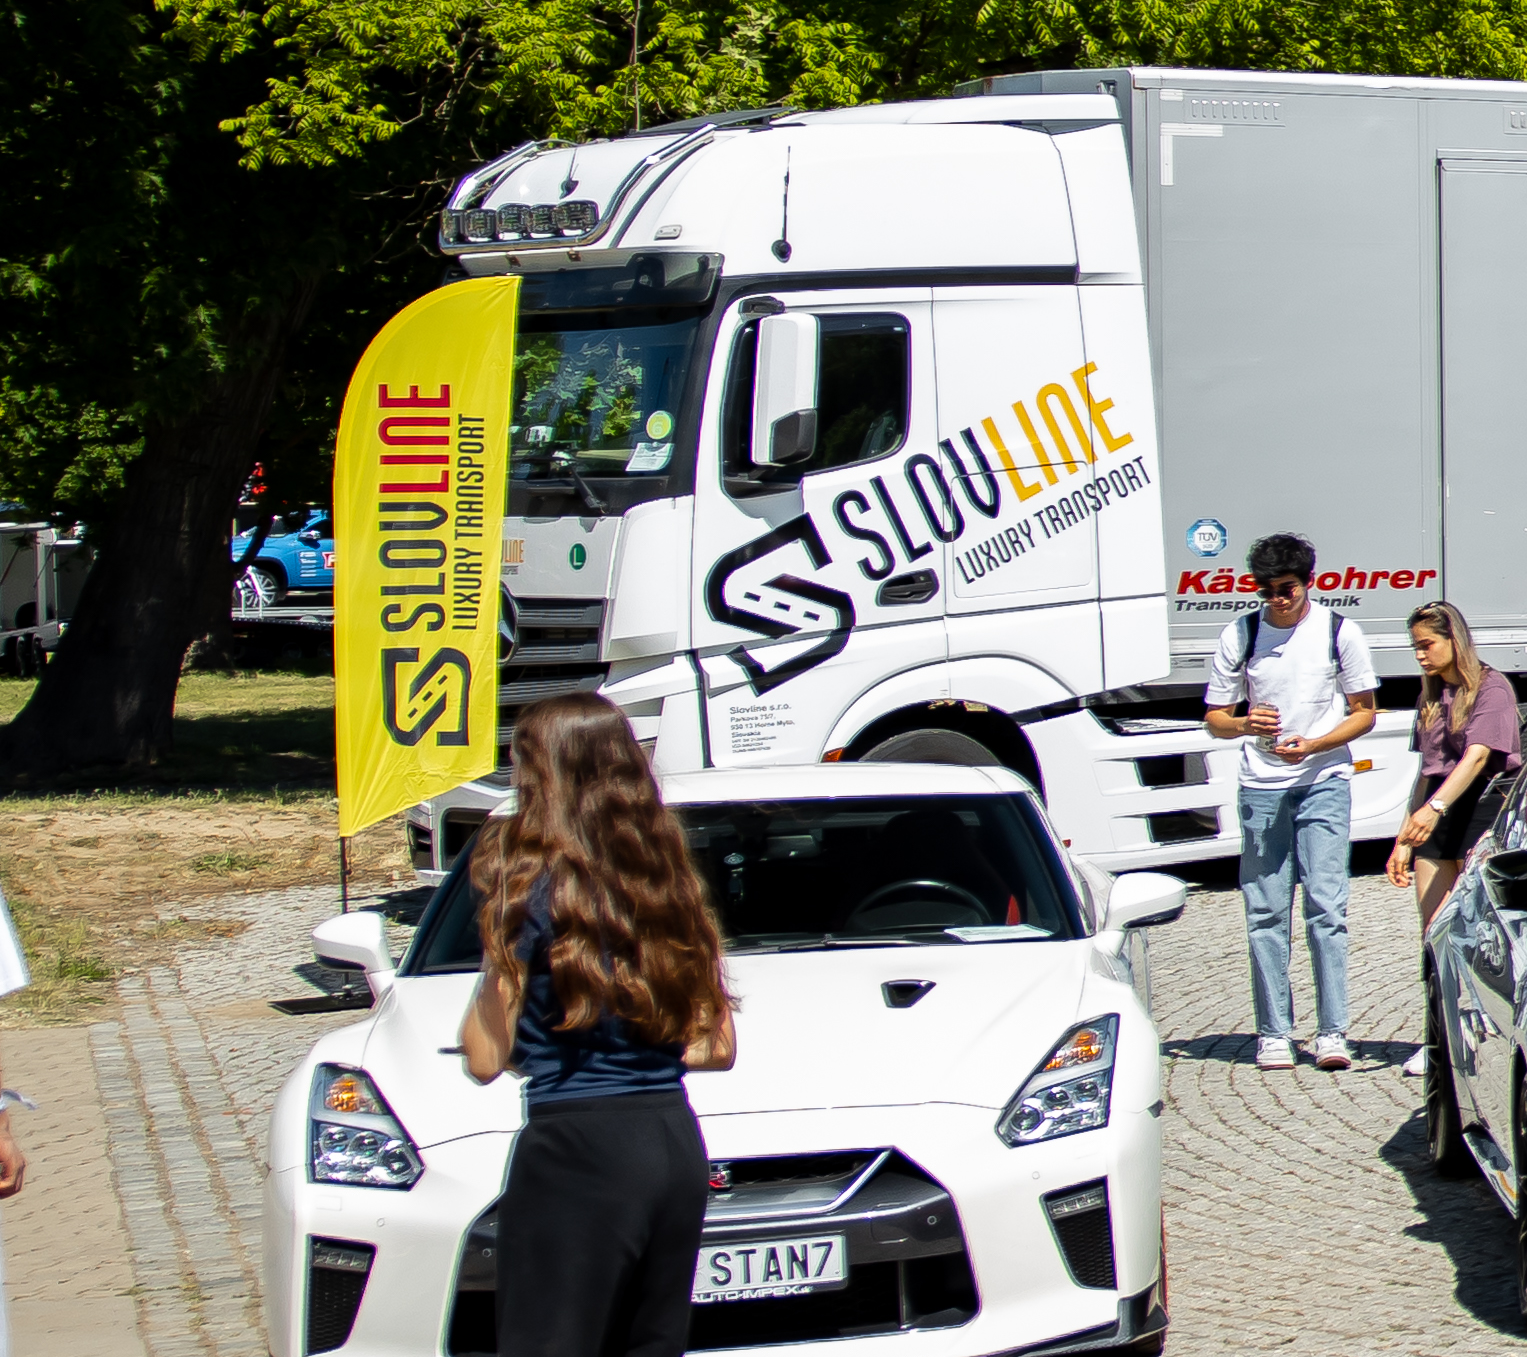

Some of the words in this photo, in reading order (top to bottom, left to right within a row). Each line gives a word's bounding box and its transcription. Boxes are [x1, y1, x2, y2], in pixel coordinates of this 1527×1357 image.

[378, 383, 451, 633] SLOVLINE
[454, 413, 486, 541] TRANSPORT
[832, 360, 1134, 581] SLOVLINE
[955, 519, 1036, 585] LUXURY
[1034, 455, 1152, 540] TRANSPORT
[451, 546, 483, 631] LUXURY
[1176, 566, 1437, 595] Käsohrer
[709, 1241, 833, 1286] STAN7
